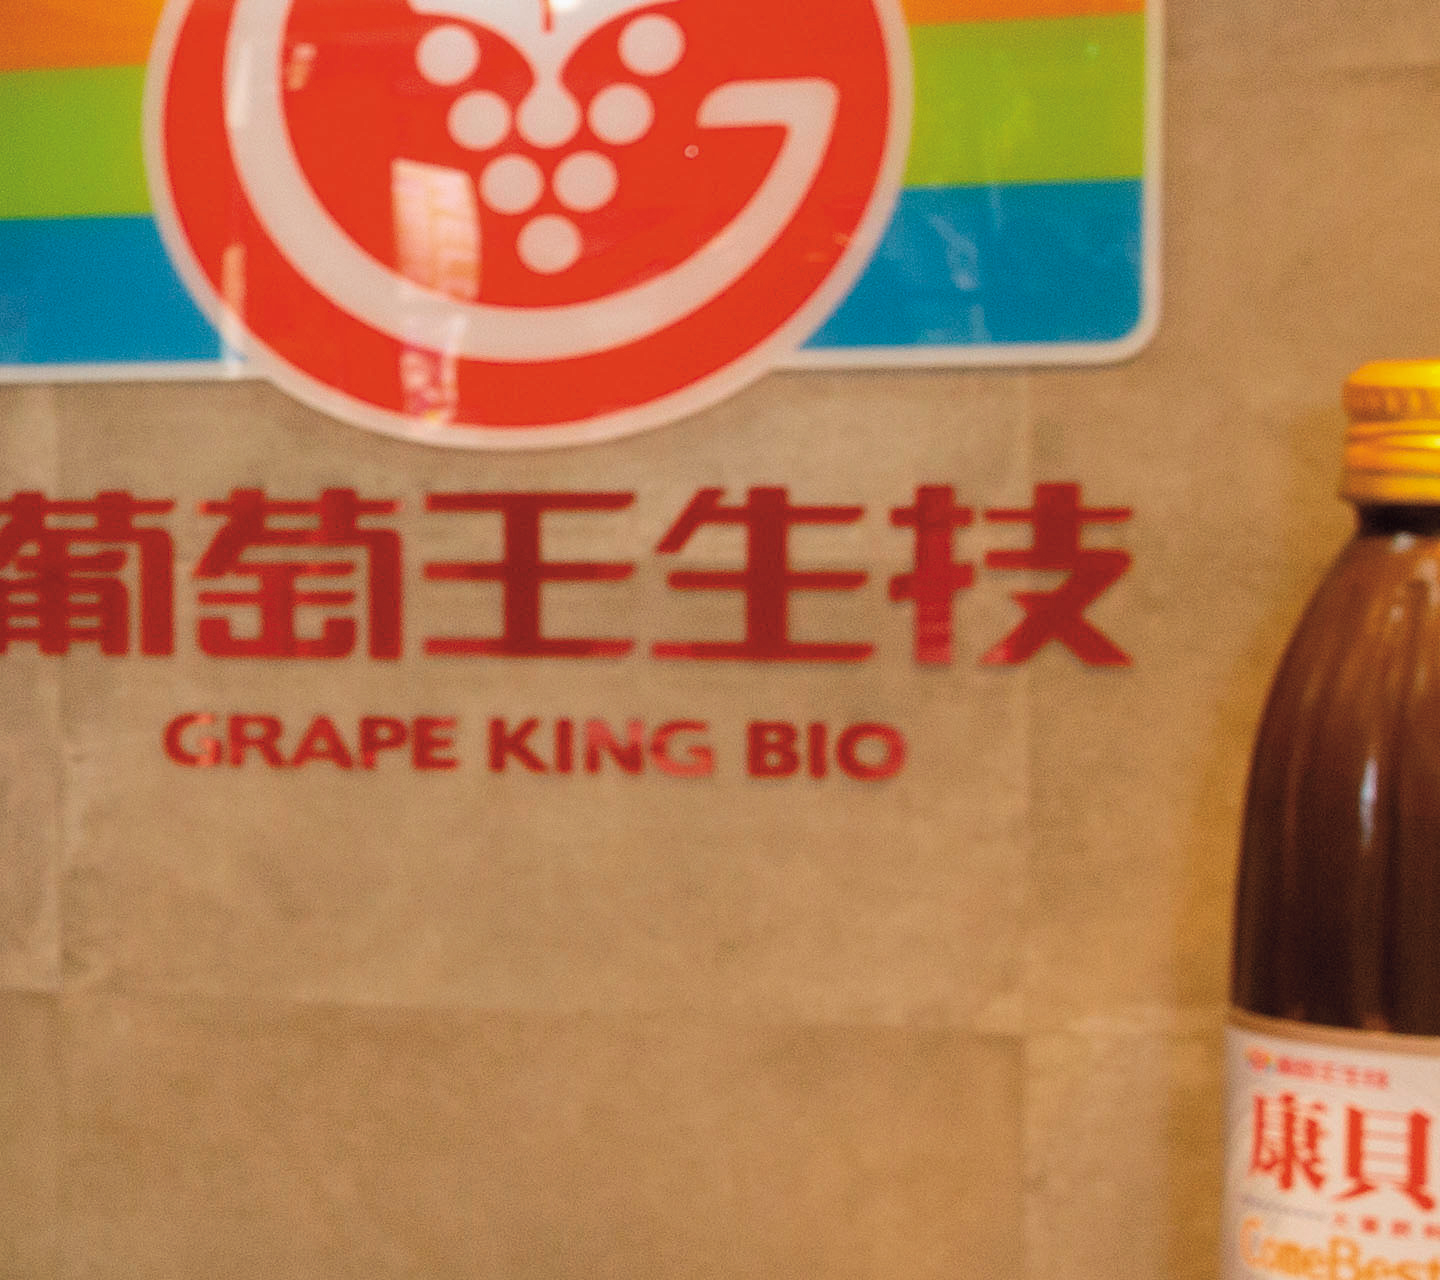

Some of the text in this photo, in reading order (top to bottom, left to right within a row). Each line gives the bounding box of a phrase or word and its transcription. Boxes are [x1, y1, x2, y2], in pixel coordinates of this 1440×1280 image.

[162, 713, 907, 783] GRAPE KING BIO
